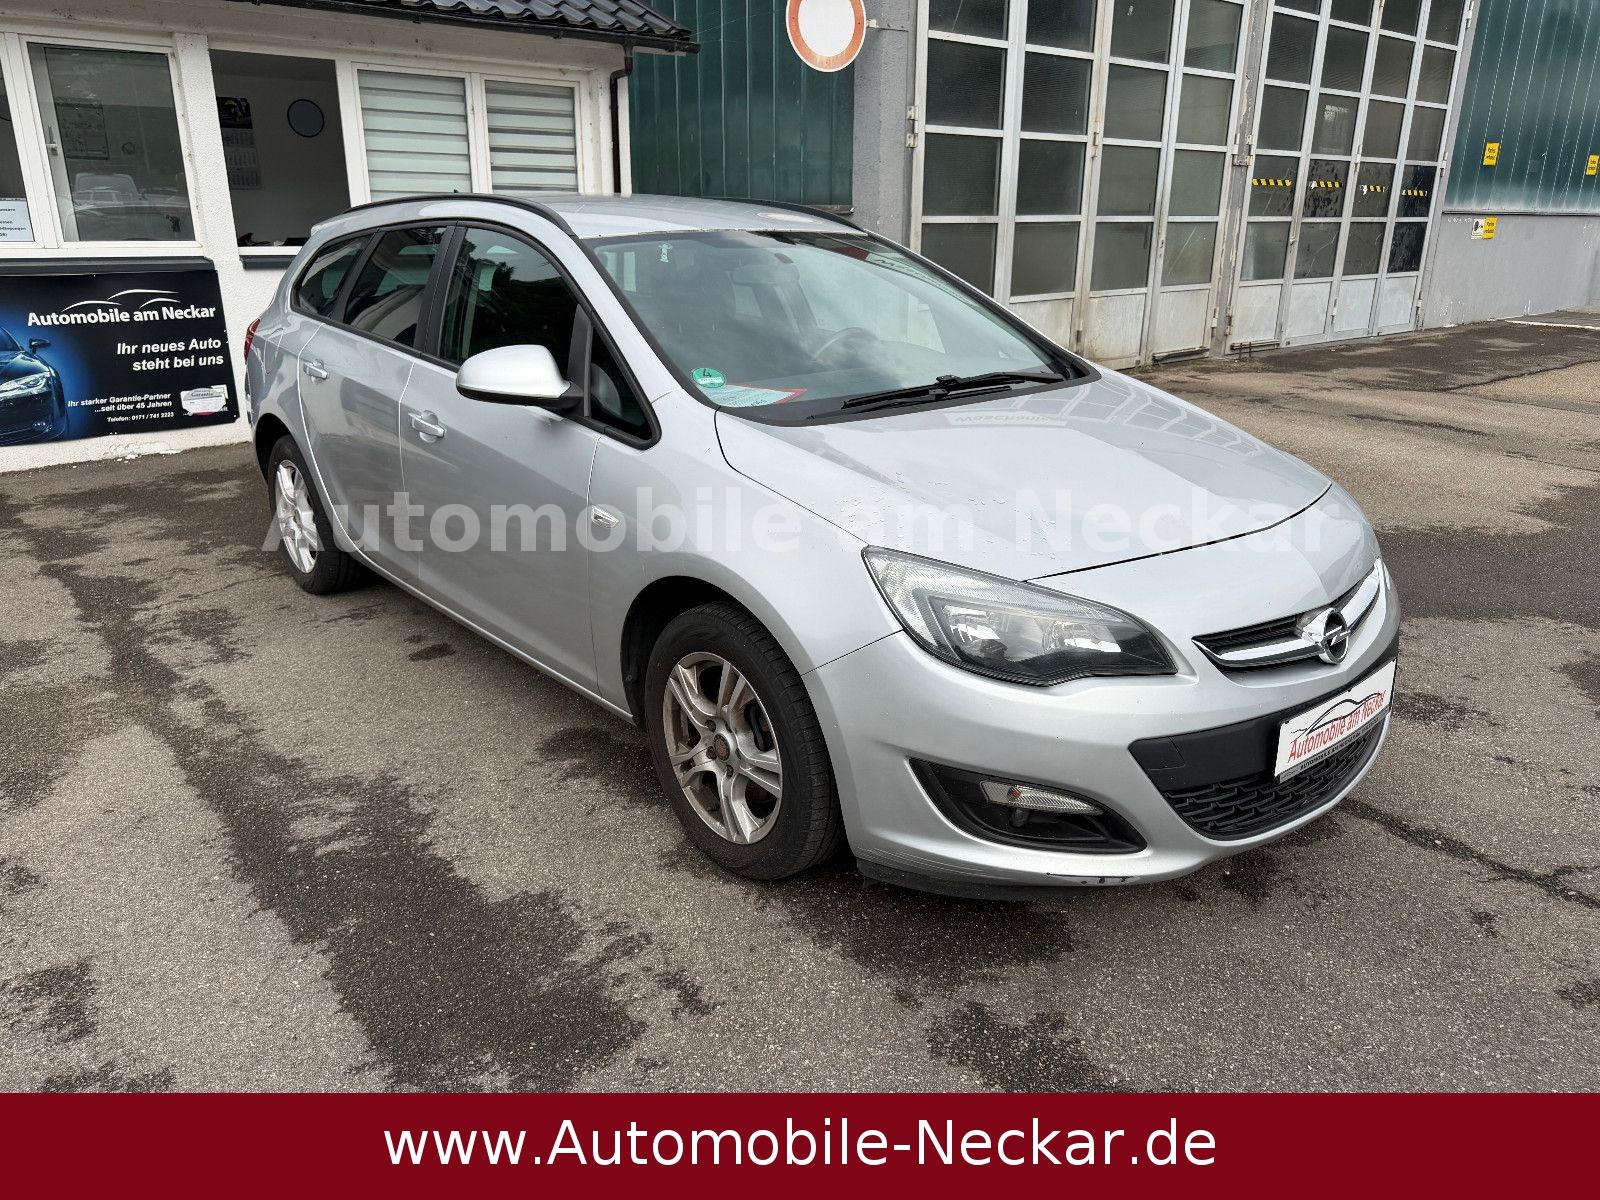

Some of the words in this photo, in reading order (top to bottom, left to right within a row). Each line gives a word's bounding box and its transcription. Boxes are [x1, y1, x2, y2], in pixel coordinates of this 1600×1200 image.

[27, 308, 130, 327] Automobile
[133, 309, 160, 323] am
[162, 304, 216, 321] Neckar
[116, 342, 138, 355] Ihr
[141, 341, 185, 354] neues
[188, 338, 222, 351] Auto
[132, 357, 170, 371] steht
[173, 355, 195, 368] bei
[198, 354, 224, 366] uns
[80, 397, 108, 406] starker
[109, 393, 172, 404] Garantie-Partner
[116, 402, 135, 411] über
[135, 401, 146, 409] 45
[147, 400, 173, 409] Jahren
[107, 415, 131, 423] Telefon:
[1288, 715, 1346, 763] Automobile
[1346, 707, 1361, 731] am
